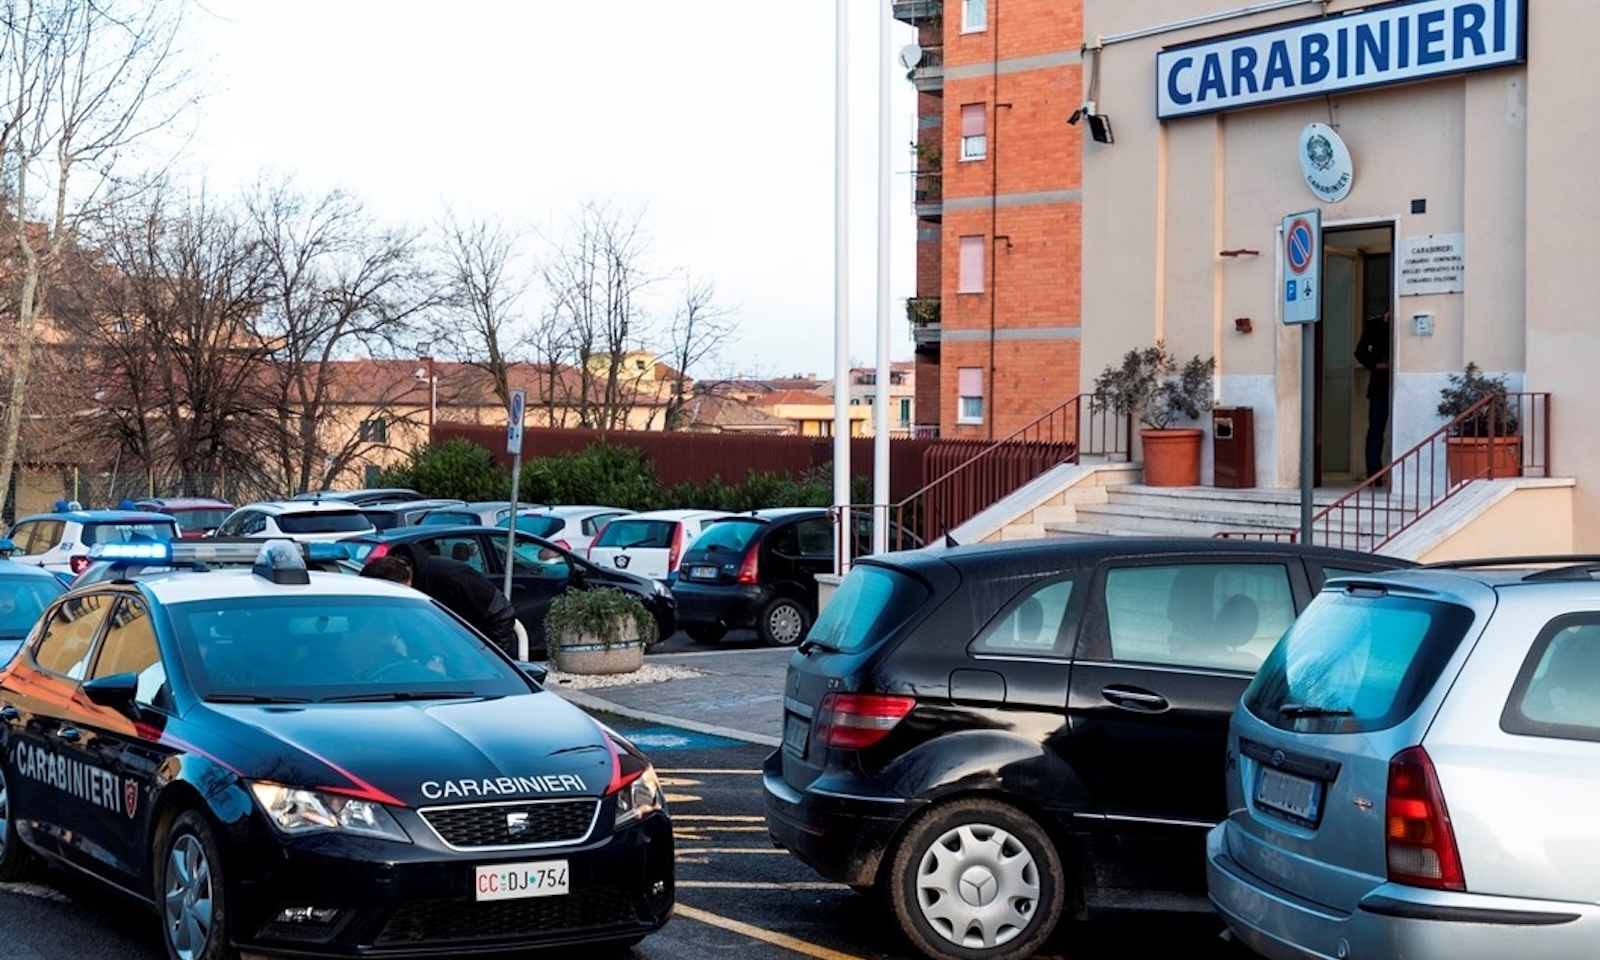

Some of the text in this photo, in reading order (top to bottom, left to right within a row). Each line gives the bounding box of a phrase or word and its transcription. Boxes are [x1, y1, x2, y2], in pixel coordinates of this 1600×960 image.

[1167, 0, 1506, 106] CARABINIERI
[16, 740, 121, 813] CARABINIERI
[421, 774, 587, 799] CARABINIERI
[537, 868, 566, 888] 754
